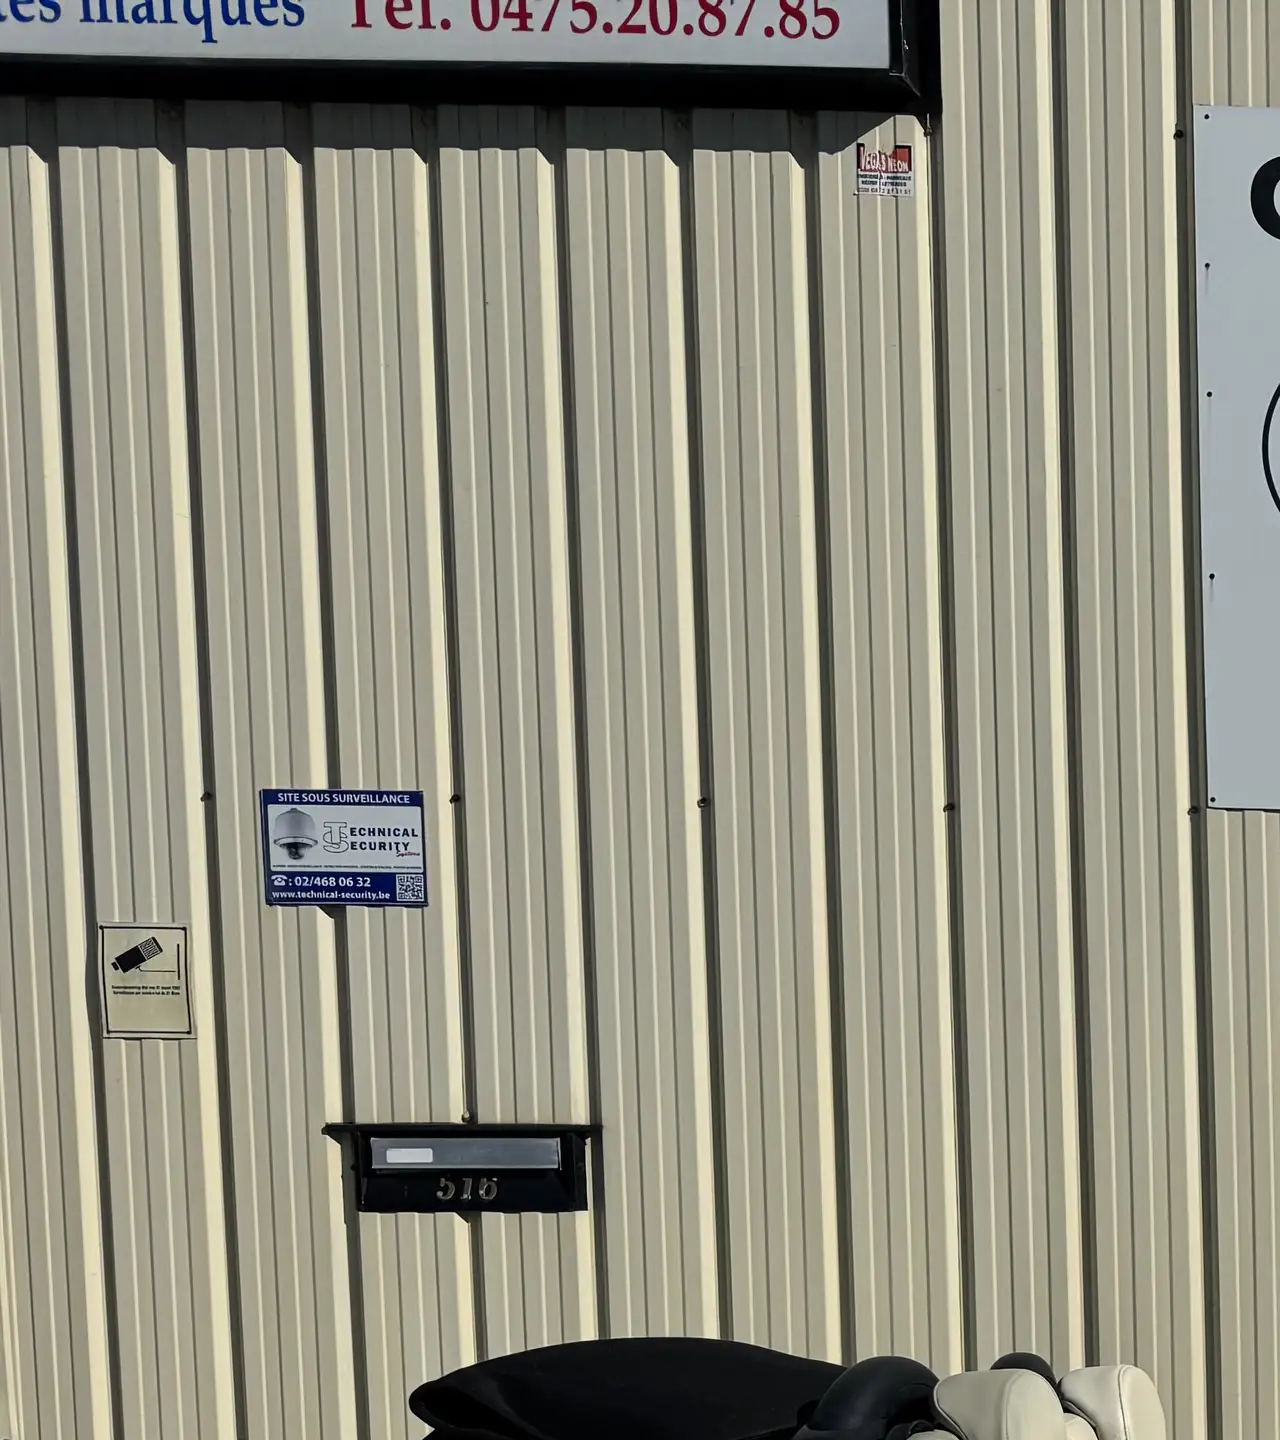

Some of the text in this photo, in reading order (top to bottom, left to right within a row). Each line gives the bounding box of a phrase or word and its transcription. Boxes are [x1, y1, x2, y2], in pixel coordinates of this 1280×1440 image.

[0, 0, 61, 23] es
[79, 0, 305, 44] marques
[471, 0, 840, 40] 0475.20.87.85
[860, 147, 887, 171] VEGAS
[277, 792, 410, 804] SITE SOUS SURVEILLANCE
[295, 876, 337, 887] 02/468
[339, 877, 354, 887] 06
[356, 877, 371, 887] 32
[272, 890, 391, 900] www.technical-security.be
